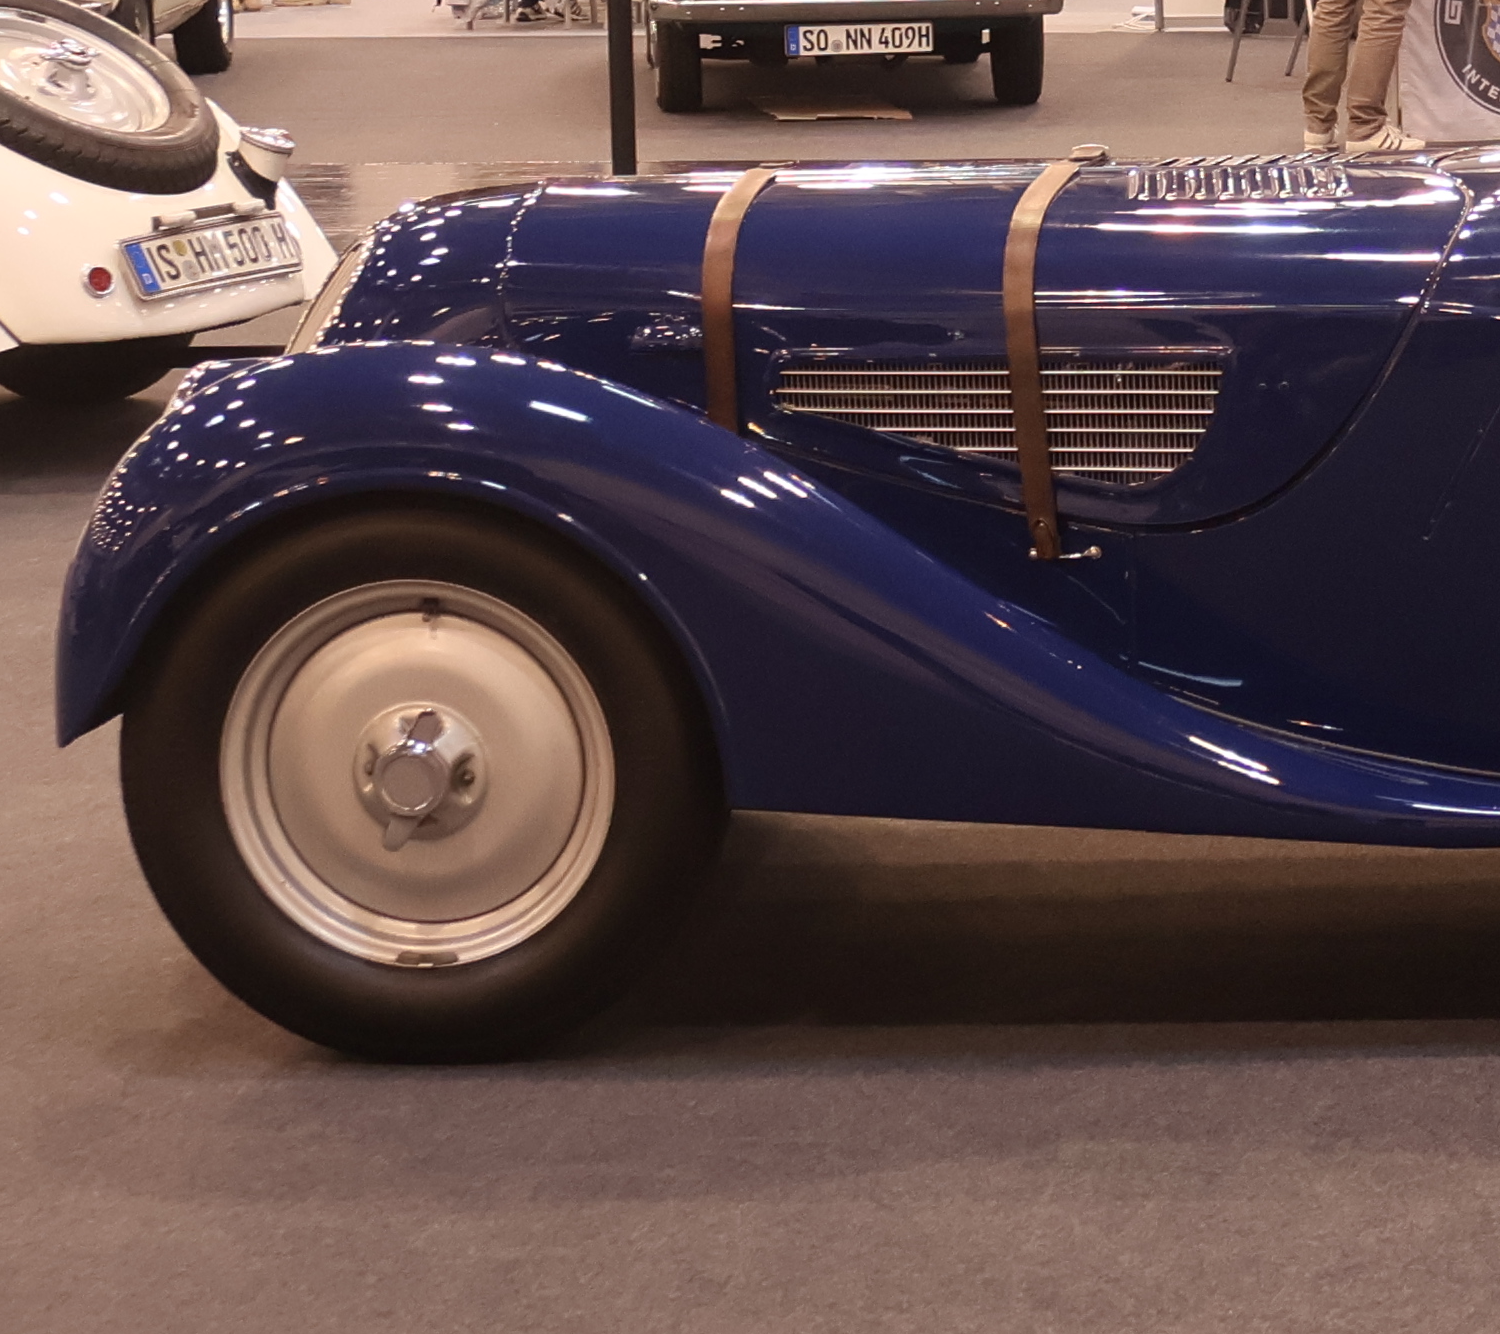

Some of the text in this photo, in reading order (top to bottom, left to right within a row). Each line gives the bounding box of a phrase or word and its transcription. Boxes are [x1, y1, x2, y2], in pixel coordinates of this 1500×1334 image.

[802, 25, 930, 52] SO NN 409H
[145, 243, 182, 283] IS
[223, 225, 272, 267] 500
